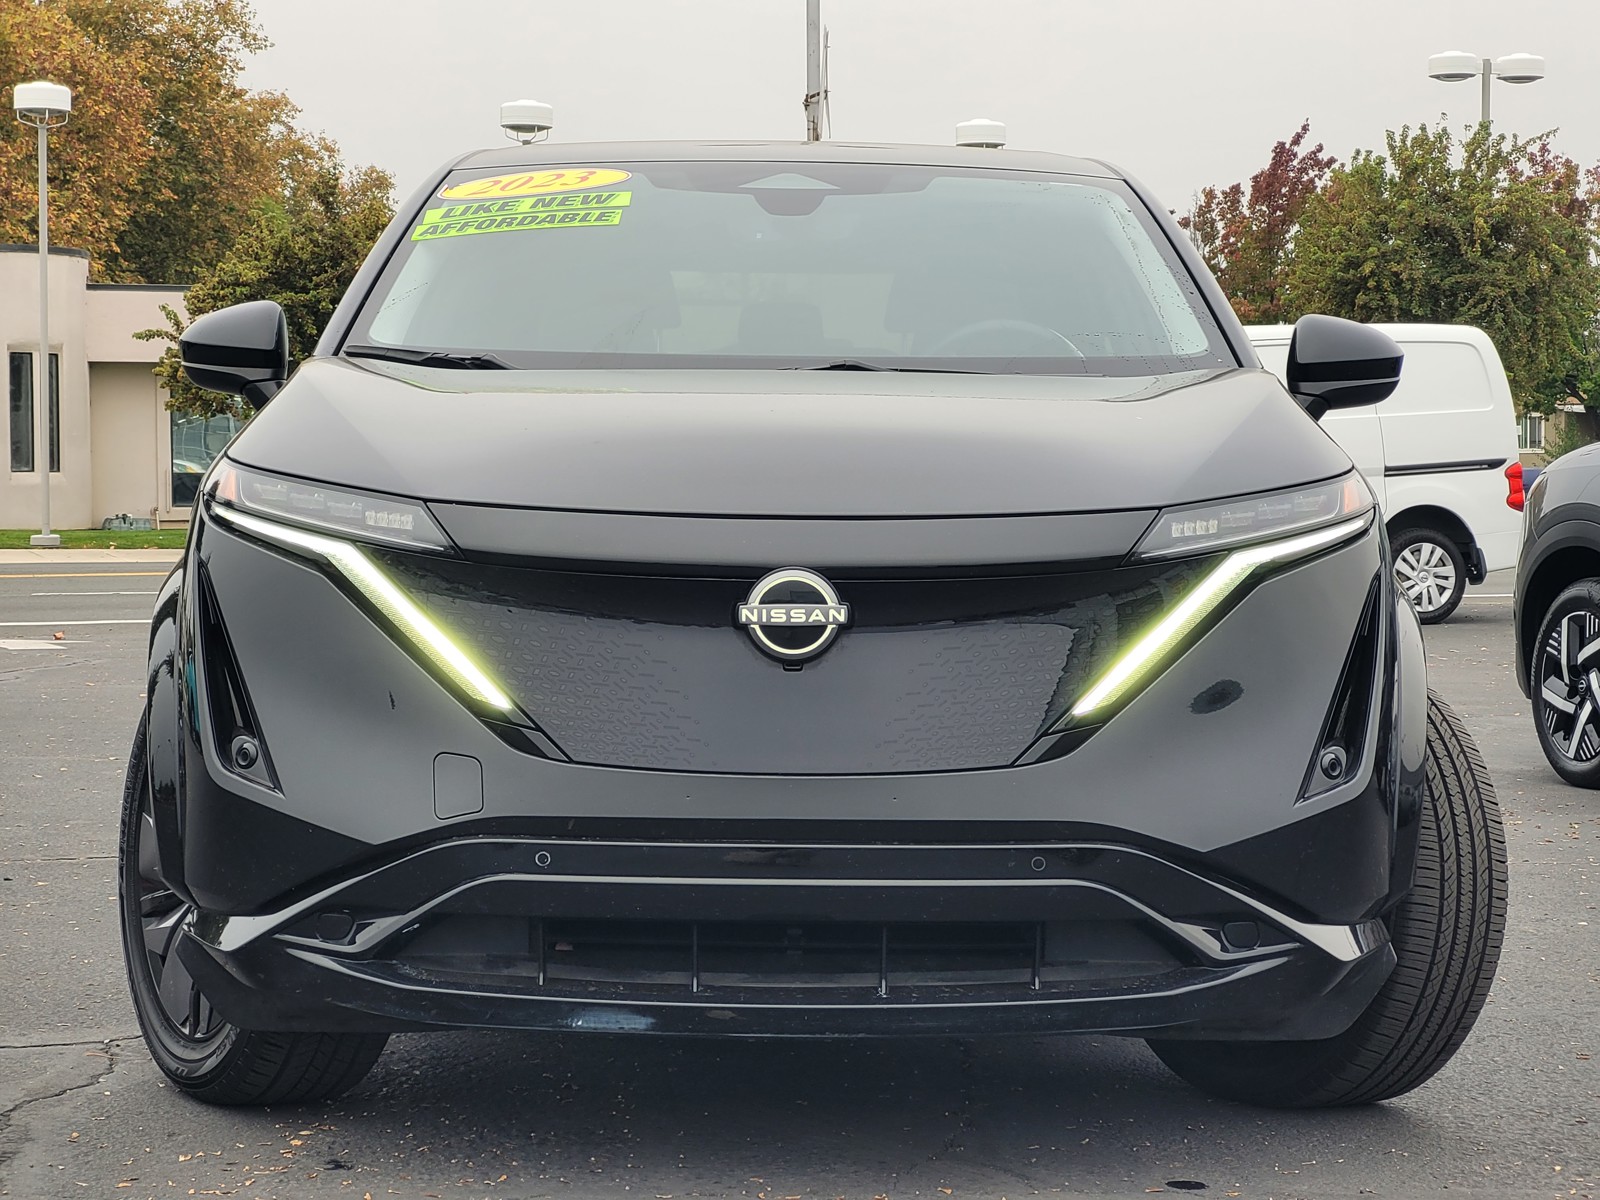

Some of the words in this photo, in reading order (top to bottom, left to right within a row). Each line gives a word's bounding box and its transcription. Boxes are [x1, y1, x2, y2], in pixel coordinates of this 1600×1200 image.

[464, 170, 598, 197] 2023
[439, 198, 522, 220] LIKE
[529, 192, 617, 210] NEW
[417, 210, 616, 237] AFFORDABLE
[741, 608, 845, 623] NISSAN
